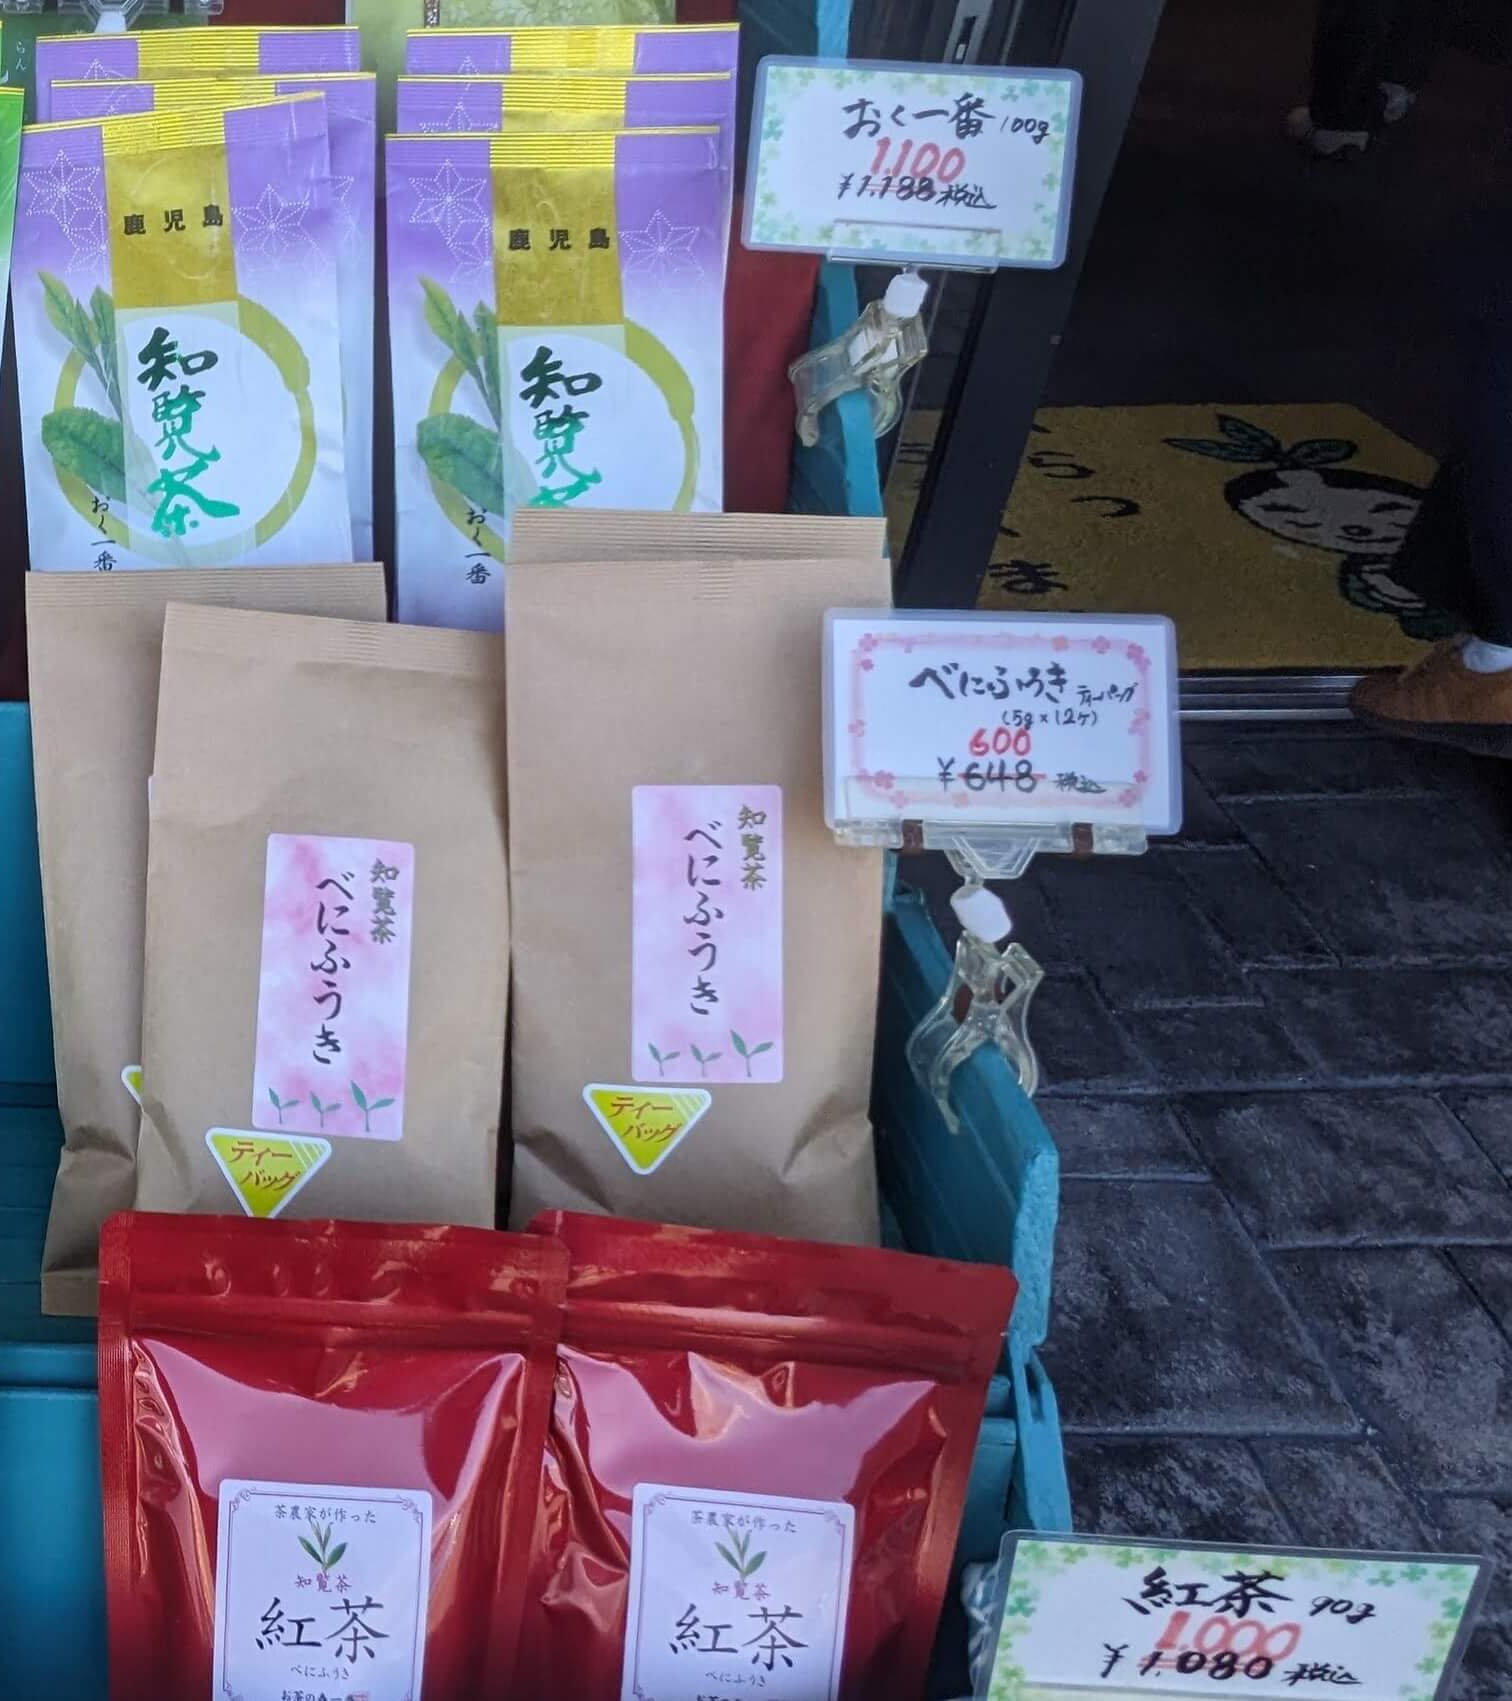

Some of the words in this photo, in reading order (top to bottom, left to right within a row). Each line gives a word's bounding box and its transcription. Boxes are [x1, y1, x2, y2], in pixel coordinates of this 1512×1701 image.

[842, 92, 995, 139] おく一番
[1000, 115, 1050, 144] 100g
[936, 183, 997, 209] 税込
[123, 205, 224, 236] 鹿児島
[508, 227, 611, 252] 鹿児島
[137, 326, 240, 539] 知覧茶
[465, 507, 492, 584] おく一番
[908, 662, 1068, 703] べにふうき
[969, 727, 1031, 757] 600
[937, 757, 1037, 792] ¥648
[1055, 771, 1107, 794] 税込
[737, 804, 767, 890] 知覧茶
[370, 858, 399, 944] 知覧茶
[683, 821, 724, 1015] べにふうき
[311, 871, 355, 1064] べにふうき
[609, 1096, 673, 1118] ティー
[623, 1123, 682, 1142] バッグ
[230, 1141, 292, 1163] ティー
[240, 1170, 300, 1190] バッグ
[275, 1504, 376, 1523] 茶農家が作った
[691, 1510, 797, 1533] 茶農家が作った
[295, 1572, 352, 1593] 知覧茶
[712, 1581, 771, 1600] 知覧茶
[1122, 1566, 1294, 1617] 紅茶
[1309, 1596, 1377, 1625] 90g
[255, 1596, 390, 1663] 紅茶
[669, 1603, 809, 1671] 紅茶
[291, 1665, 349, 1680] べにふうき
[705, 1671, 766, 1688] べにふうき
[1282, 1662, 1364, 1687] 税込
